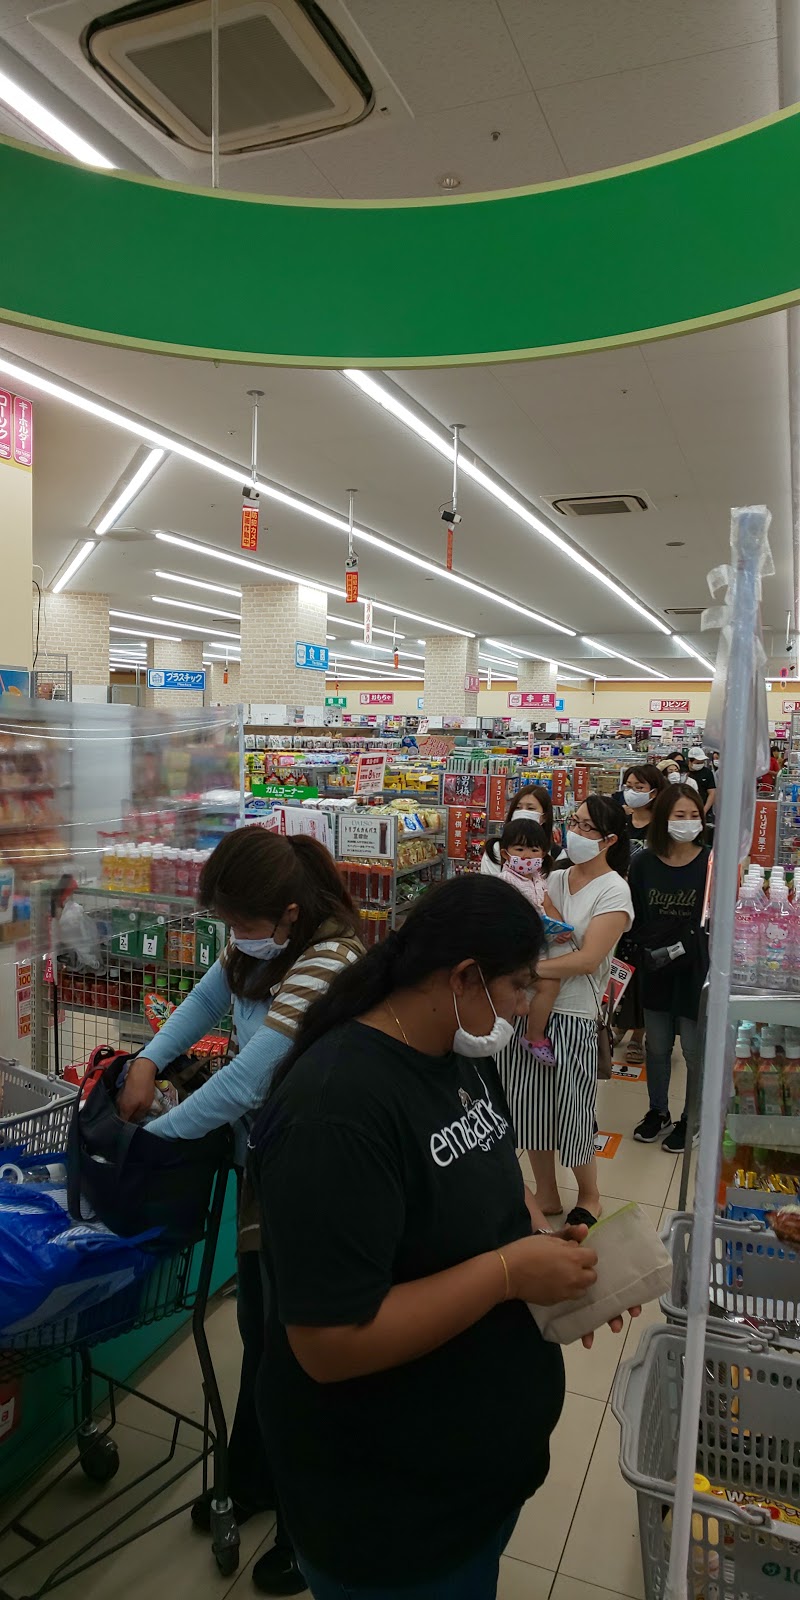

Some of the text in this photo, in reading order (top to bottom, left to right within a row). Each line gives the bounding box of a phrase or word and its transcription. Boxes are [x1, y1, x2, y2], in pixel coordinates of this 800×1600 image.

[18, 401, 29, 449] キーホルダー
[165, 671, 203, 683] プラスチック
[265, 786, 304, 795] ガムコーナー
[454, 811, 462, 847] 子供菓子
[758, 806, 768, 853] よりどり菓子
[477, 1135, 494, 1152] Sri
